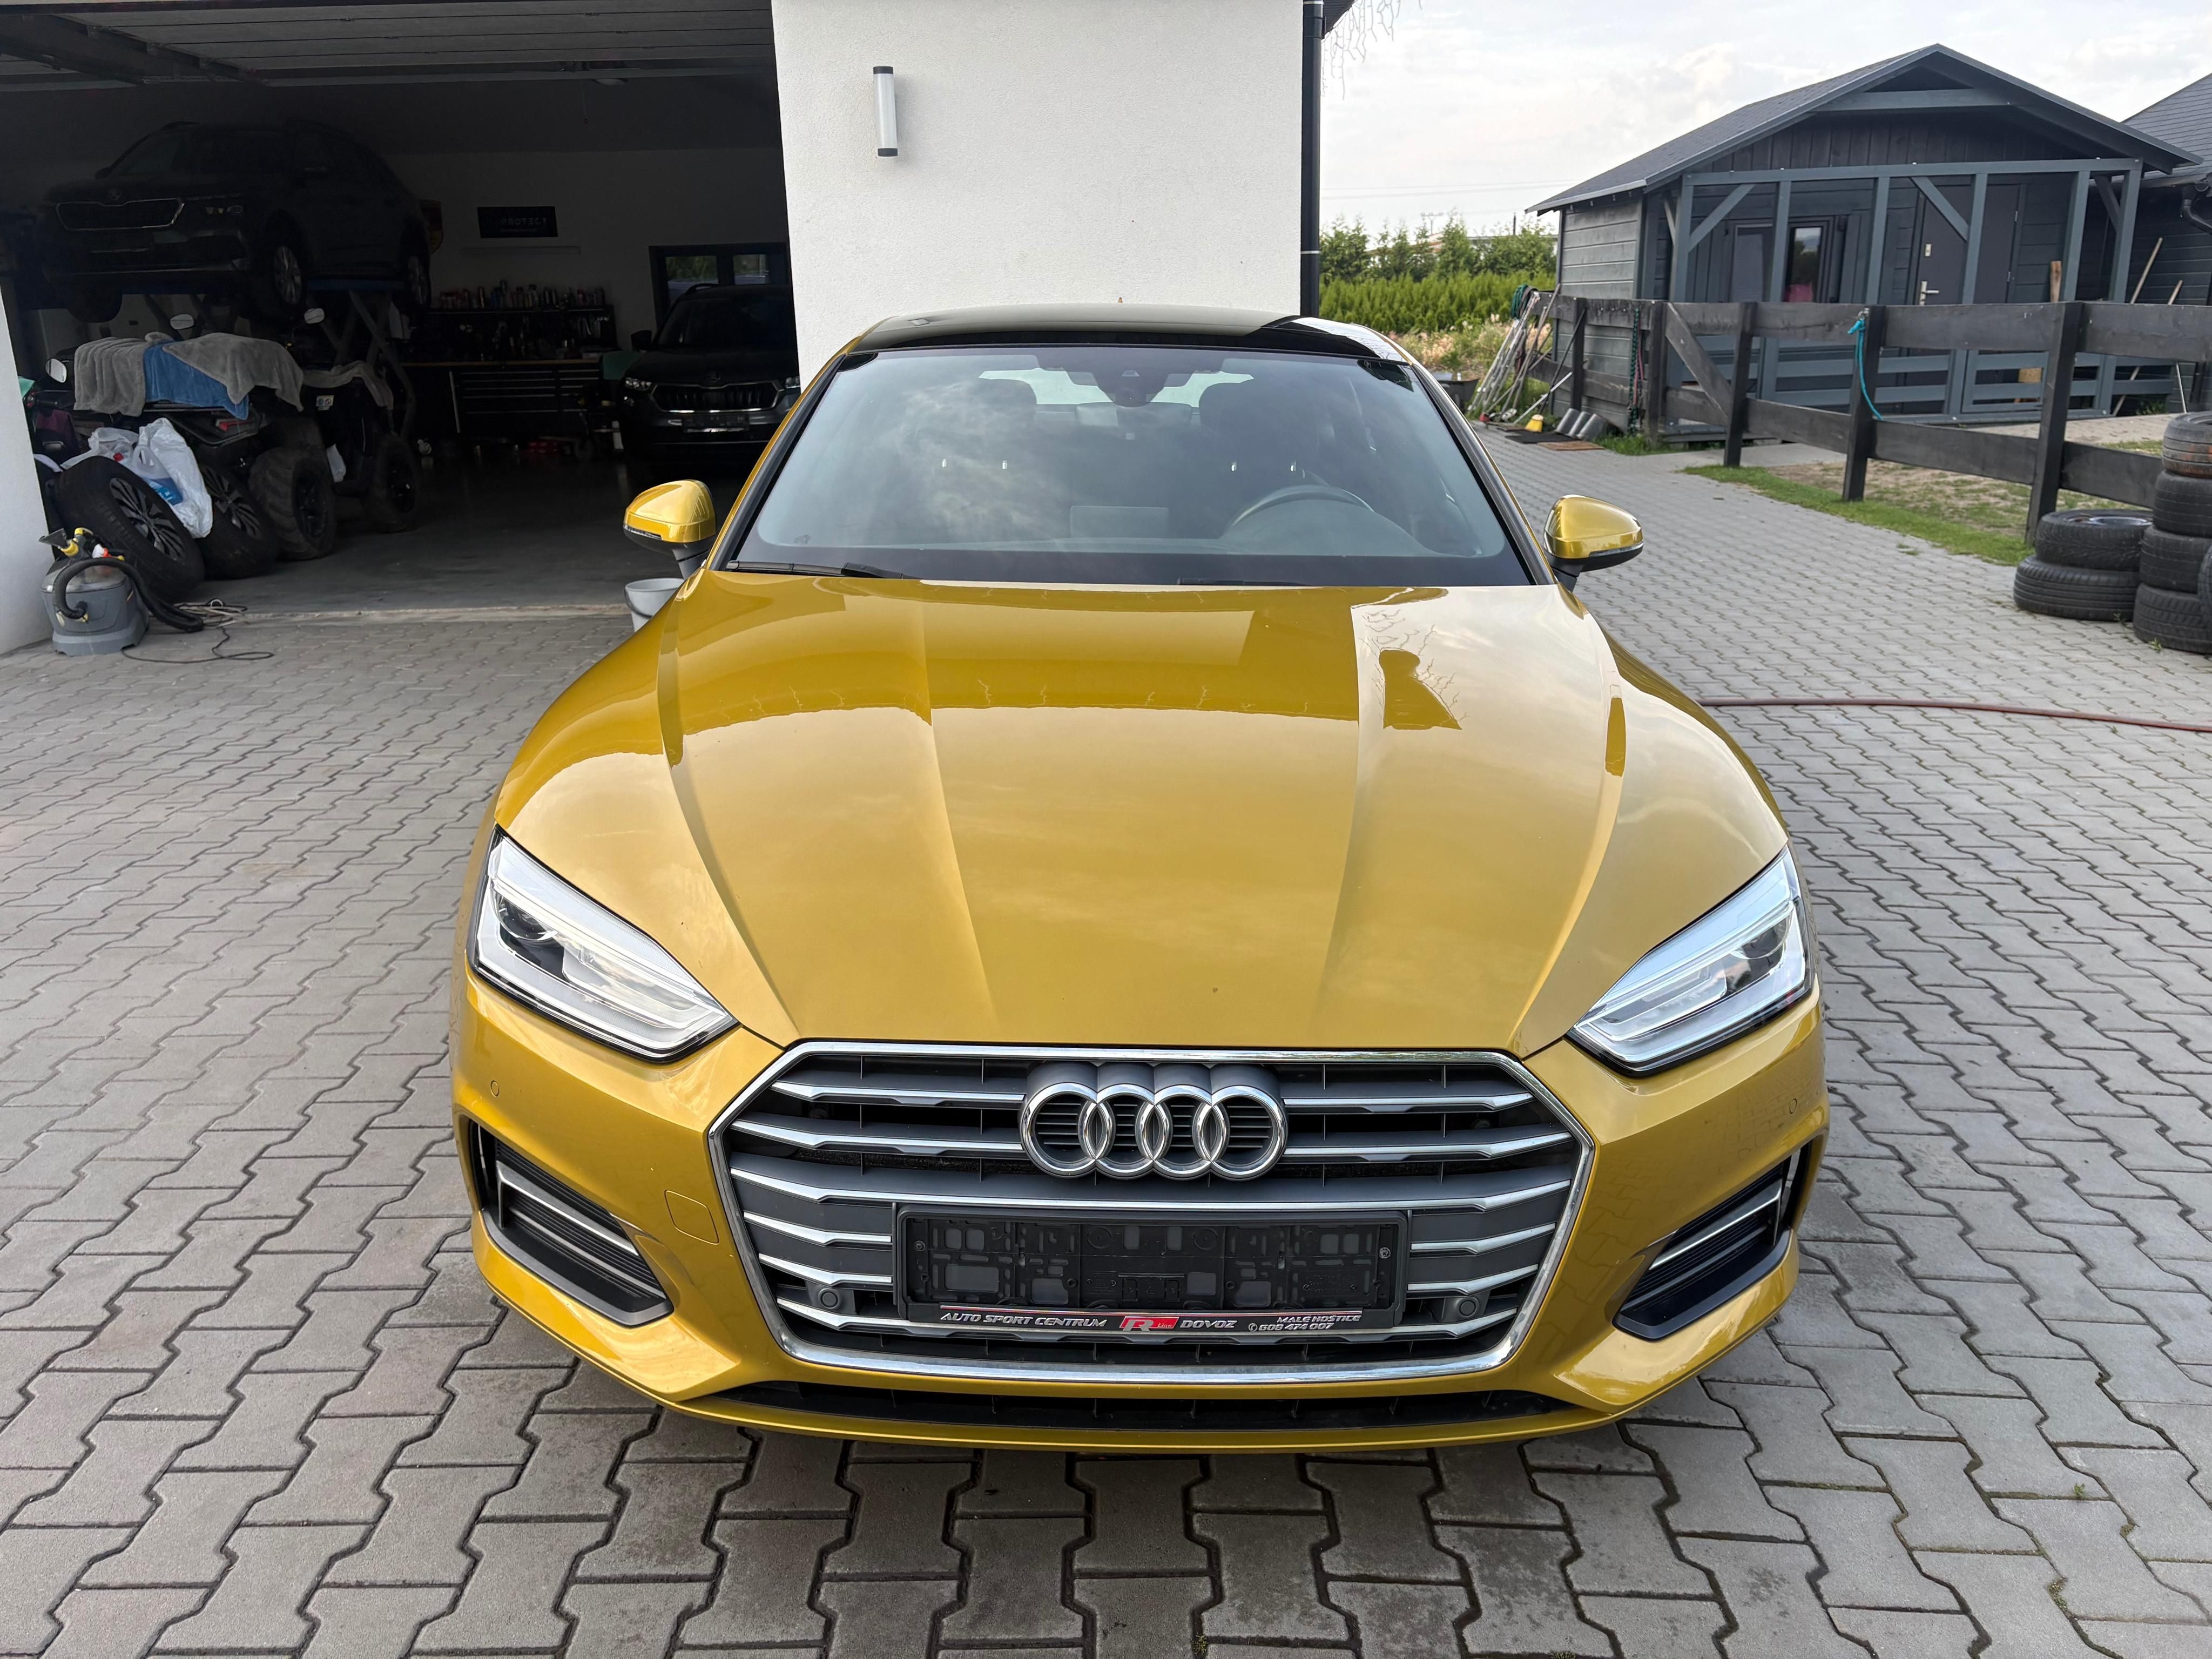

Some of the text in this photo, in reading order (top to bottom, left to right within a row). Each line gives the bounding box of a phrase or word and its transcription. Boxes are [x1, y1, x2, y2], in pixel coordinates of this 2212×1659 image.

[501, 217, 547, 225] PROTECT
[940, 1313, 1108, 1327] AUTO SPORT CENTRUM
[1277, 1314, 1363, 1323] MALÉ HOŠTICE
[1122, 1319, 1154, 1331] R
[1180, 1320, 1238, 1328] DOVOZ
